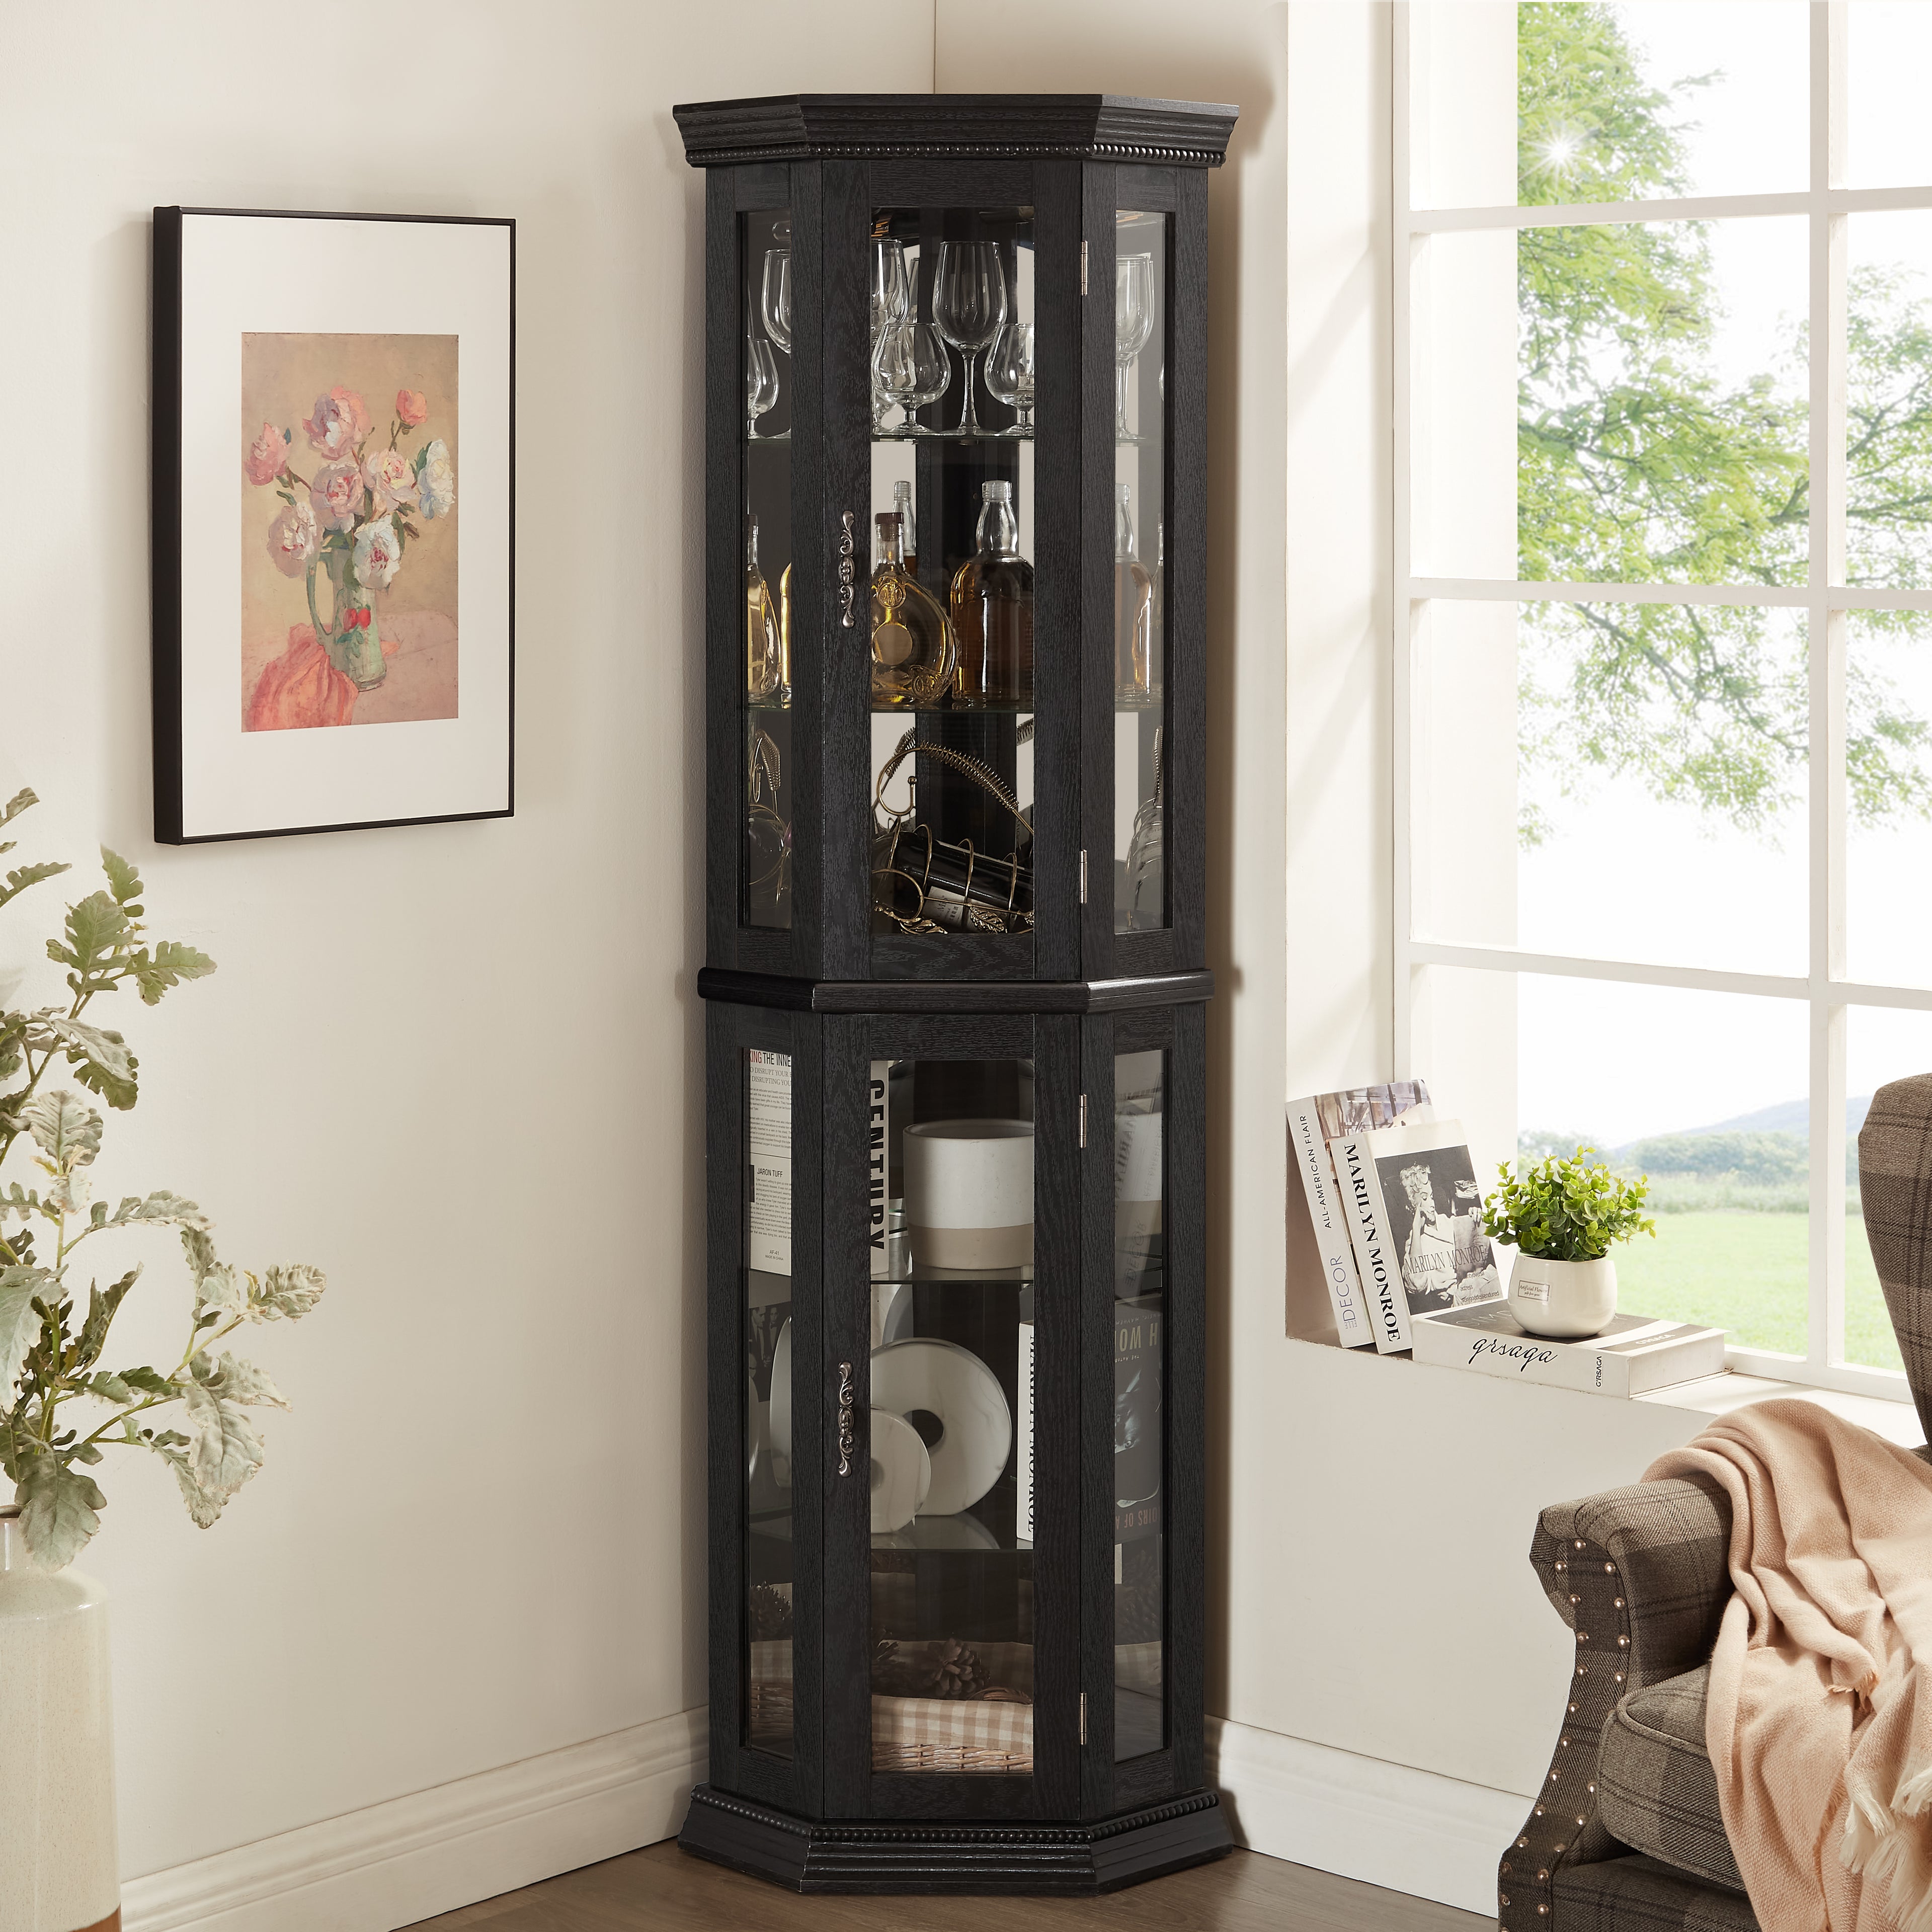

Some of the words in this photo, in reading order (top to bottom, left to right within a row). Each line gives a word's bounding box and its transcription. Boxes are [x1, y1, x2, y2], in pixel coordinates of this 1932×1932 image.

[755, 1067, 774, 1075] DISRUPT
[763, 1053, 774, 1065] THE
[752, 1076, 780, 1085] DISRUPTING
[1300, 1115, 1312, 1144] FLAIR
[757, 1168, 771, 1176] JARON
[1307, 1149, 1332, 1228] ALL-AMERICAN
[1344, 1143, 1378, 1242] MARILYN
[1369, 1247, 1400, 1342] MONROE
[1405, 1252, 1445, 1274] MARILYN
[1446, 1245, 1486, 1267] MONROE
[1330, 1255, 1355, 1322] DECOR
[1115, 1325, 1141, 1352] WO
[1124, 1512, 1134, 1528] OF
